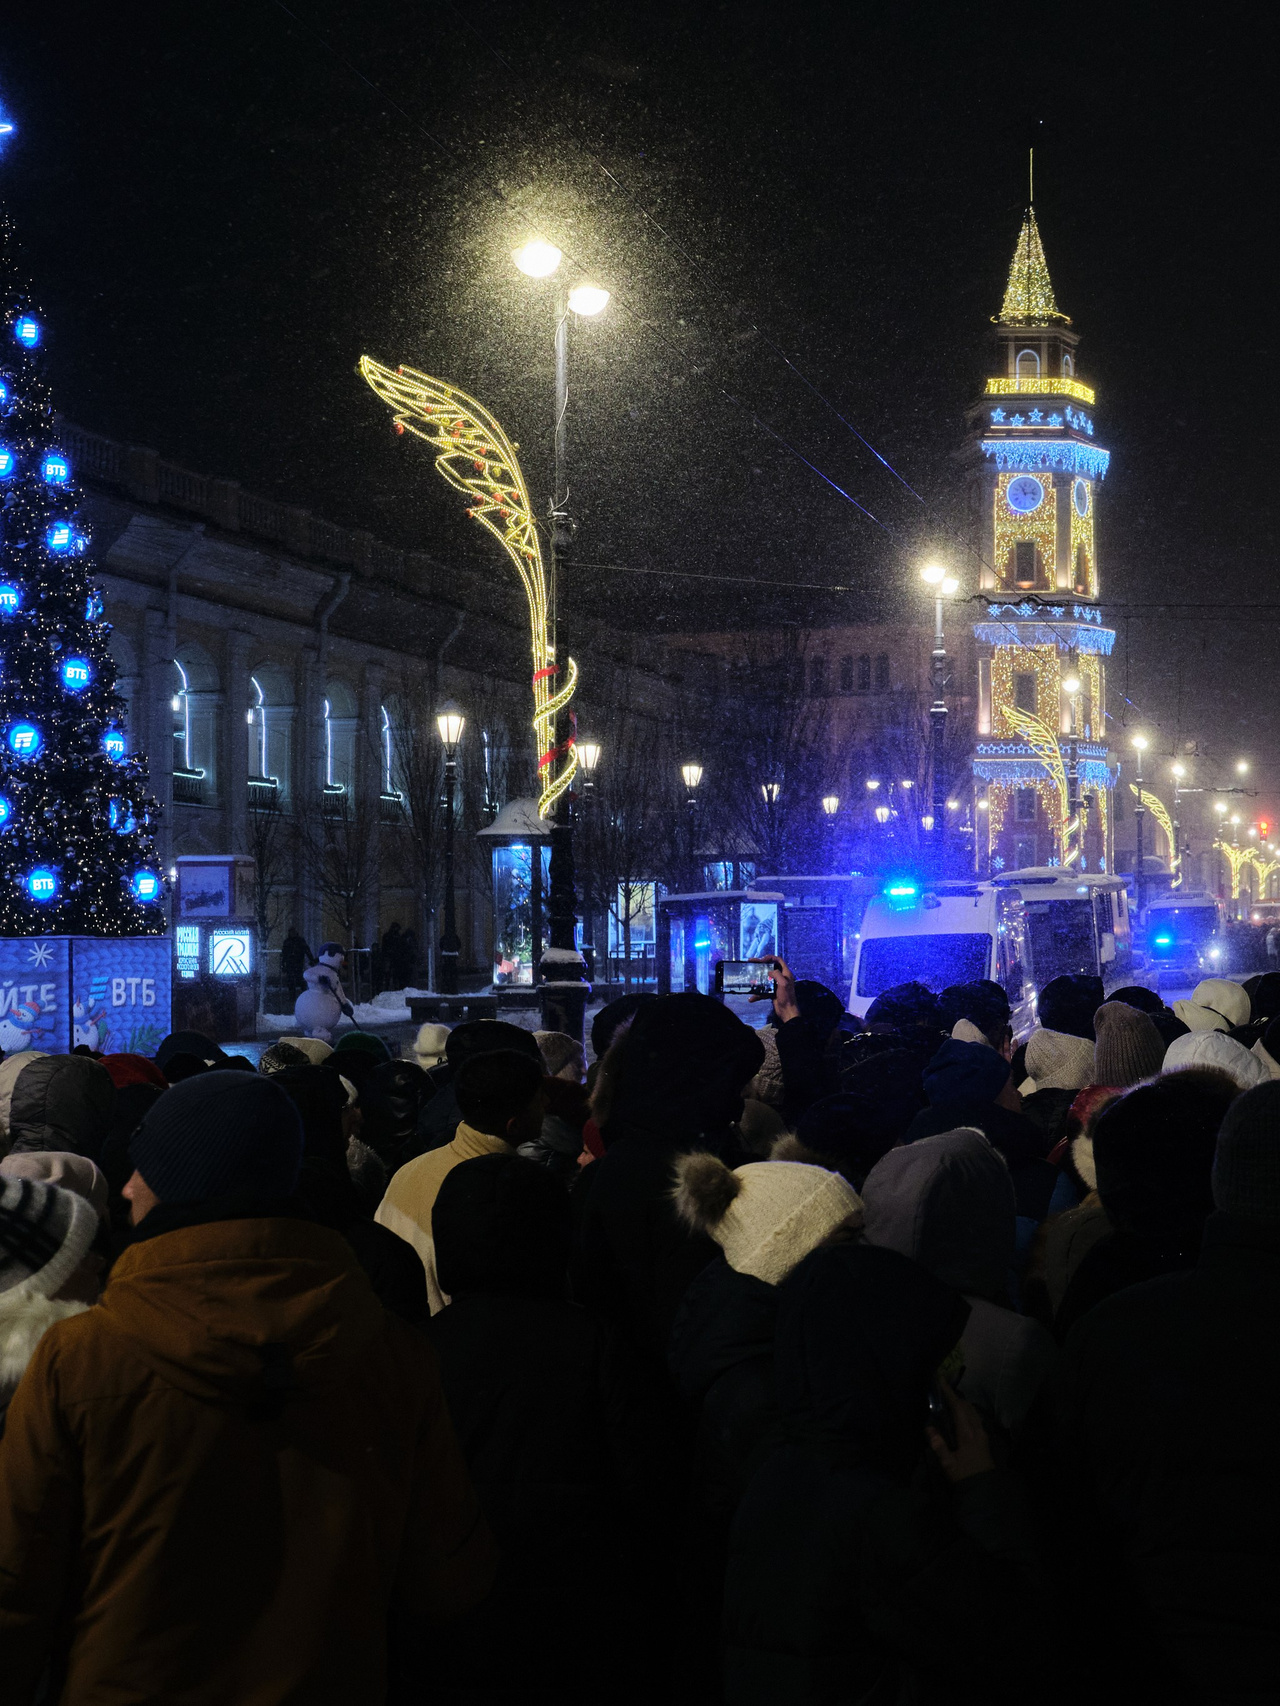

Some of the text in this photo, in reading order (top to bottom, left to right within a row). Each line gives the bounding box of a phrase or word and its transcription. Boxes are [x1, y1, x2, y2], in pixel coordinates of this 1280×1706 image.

[46, 465, 66, 477] ВТБ
[67, 668, 87, 680] ВТБ
[33, 879, 54, 891] ВТБ
[112, 978, 155, 1007] ВТБ
